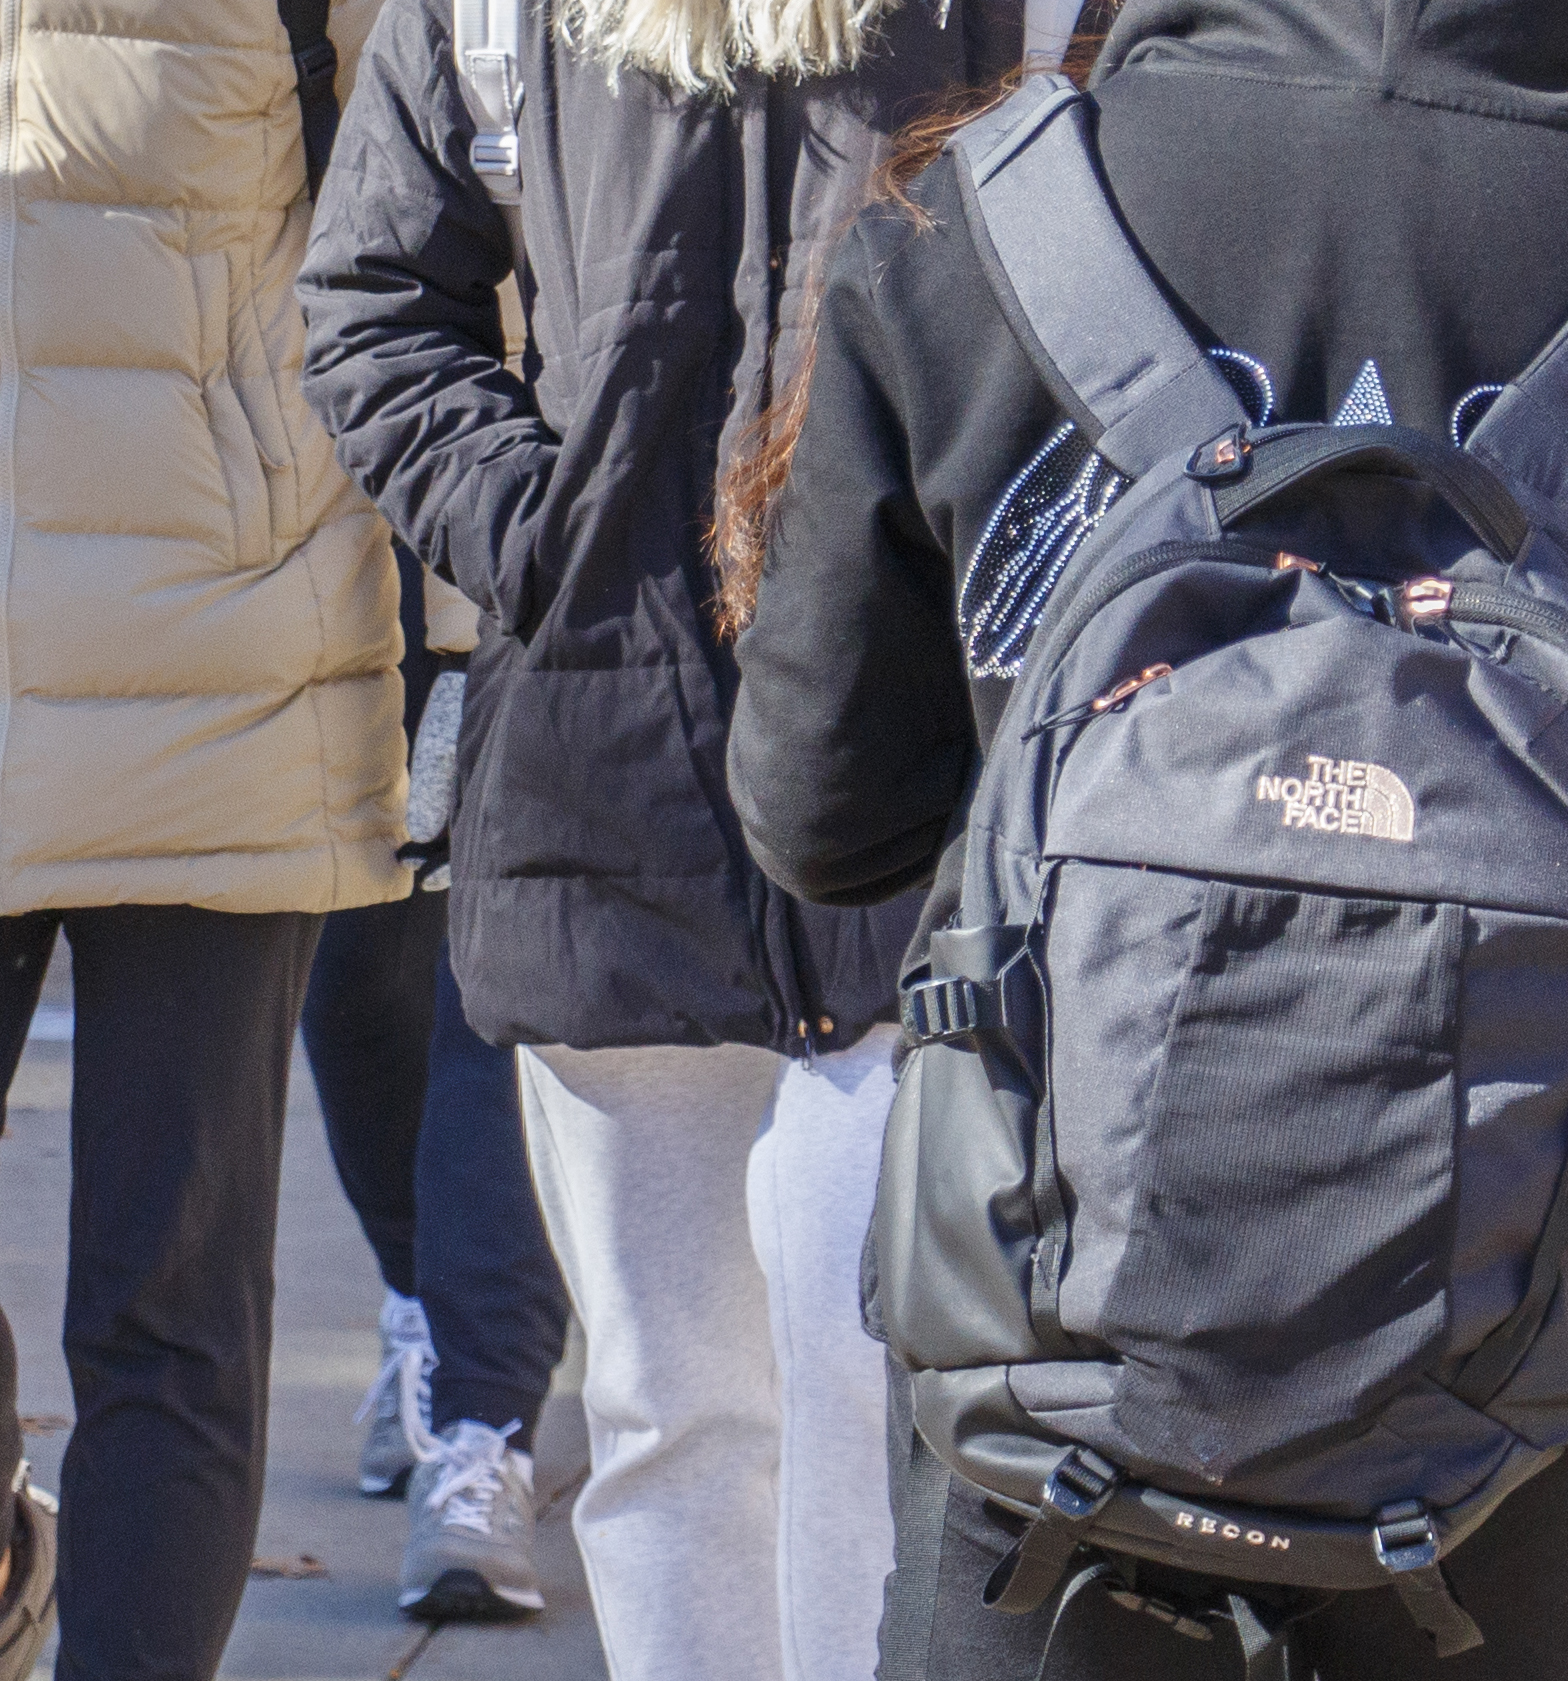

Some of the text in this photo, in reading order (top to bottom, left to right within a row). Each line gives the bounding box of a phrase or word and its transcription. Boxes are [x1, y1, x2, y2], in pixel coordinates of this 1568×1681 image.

[1308, 754, 1368, 787] THE
[1256, 775, 1365, 811] NORTH
[1284, 801, 1361, 834] FACE
[1175, 1510, 1291, 1550] RECON
